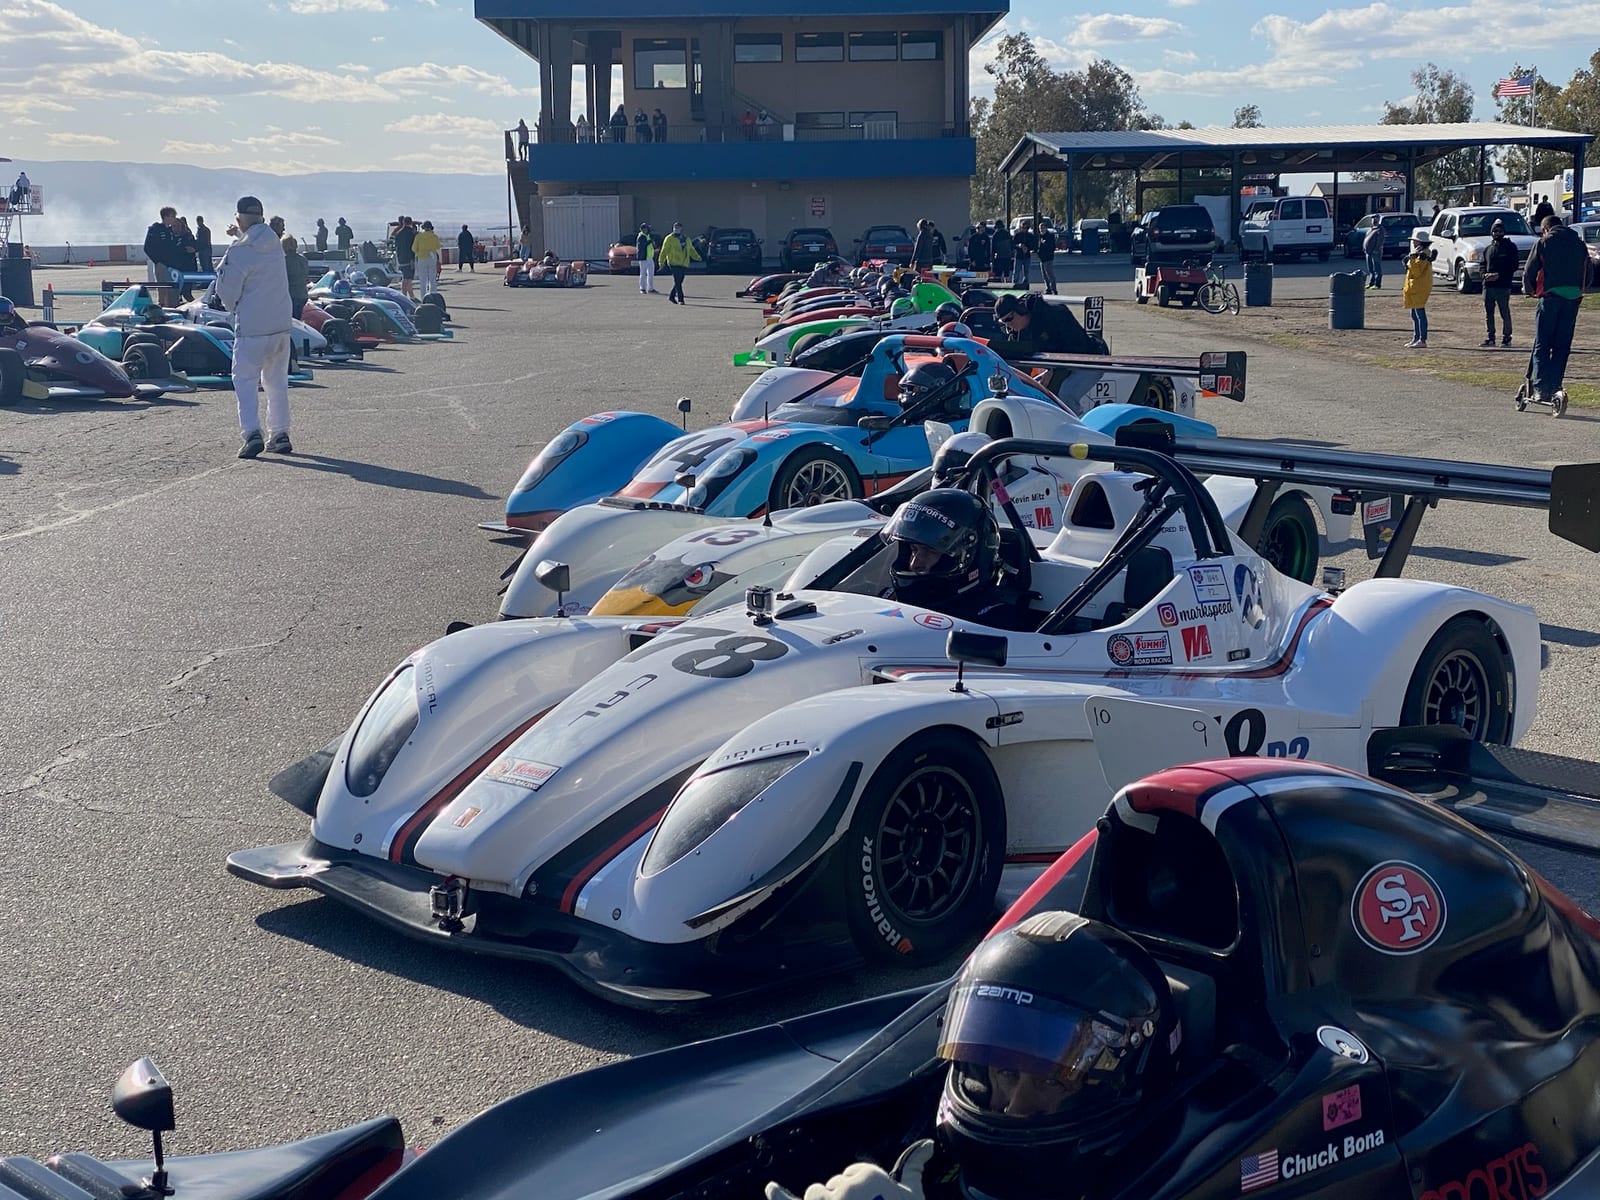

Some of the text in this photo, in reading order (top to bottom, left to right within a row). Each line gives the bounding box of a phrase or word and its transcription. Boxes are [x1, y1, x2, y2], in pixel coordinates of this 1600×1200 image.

[1086, 310, 1101, 330] 62
[1096, 382, 1110, 397] P2
[924, 615, 944, 627] E
[620, 626, 789, 679] 78
[1192, 720, 1208, 747] 9
[977, 985, 1034, 1005] zamp
[1281, 1129, 1385, 1179] Chuck Bona
